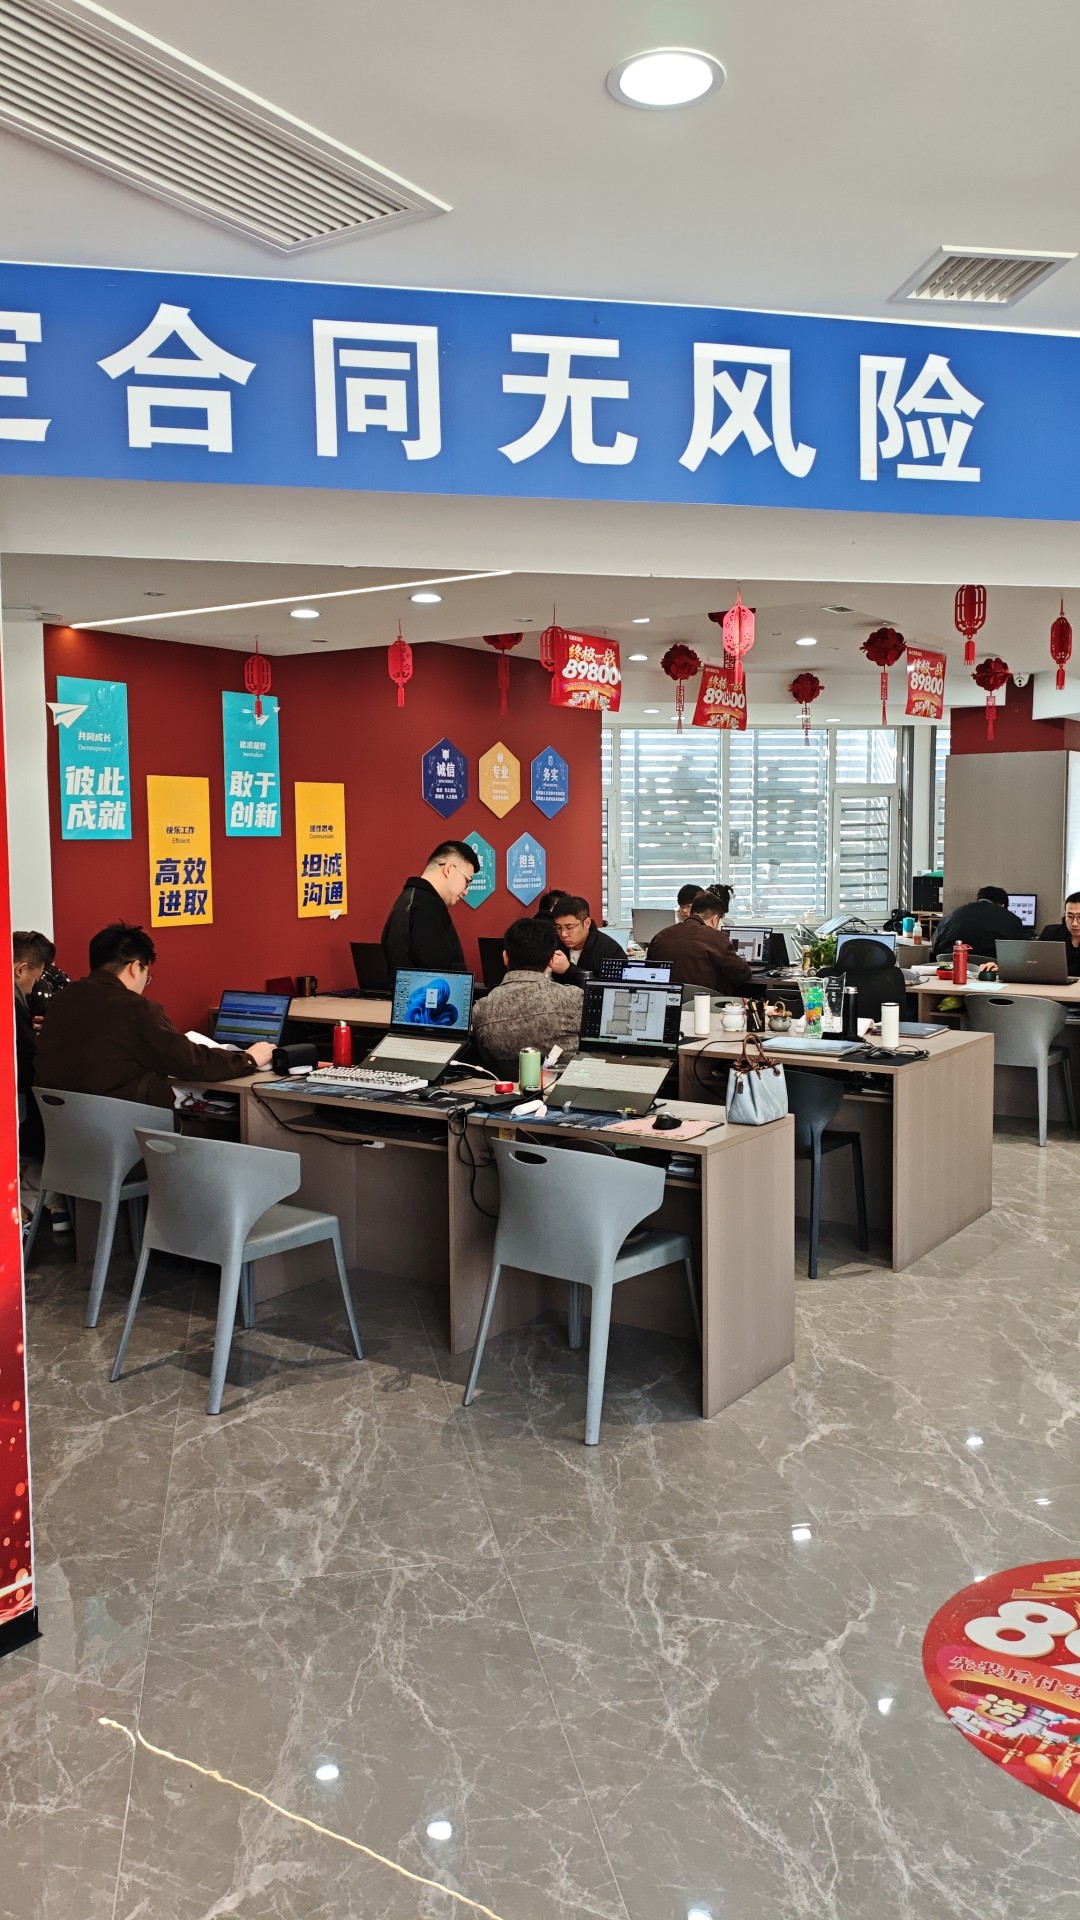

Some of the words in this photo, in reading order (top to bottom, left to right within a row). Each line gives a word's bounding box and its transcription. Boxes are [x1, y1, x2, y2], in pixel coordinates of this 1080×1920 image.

[568, 643, 616, 668] 终极一战
[561, 658, 619, 686] 89800
[910, 671, 944, 695] 89800
[78, 731, 112, 742] 共同成长
[78, 744, 112, 753] Development
[65, 765, 125, 796] 彼此
[436, 761, 456, 778] 诚信
[492, 764, 510, 779] 专业
[542, 767, 559, 781] 务实
[229, 770, 276, 798] 敢于
[66, 800, 127, 830] 成就
[230, 801, 278, 828] 创新
[166, 826, 195, 834] 快乐工作
[155, 857, 207, 886] 高效
[301, 852, 343, 878] 坦诚
[519, 854, 535, 868] 担当
[157, 889, 208, 917] 进取
[302, 881, 343, 907] 沟通
[974, 1693, 1028, 1728] 送
